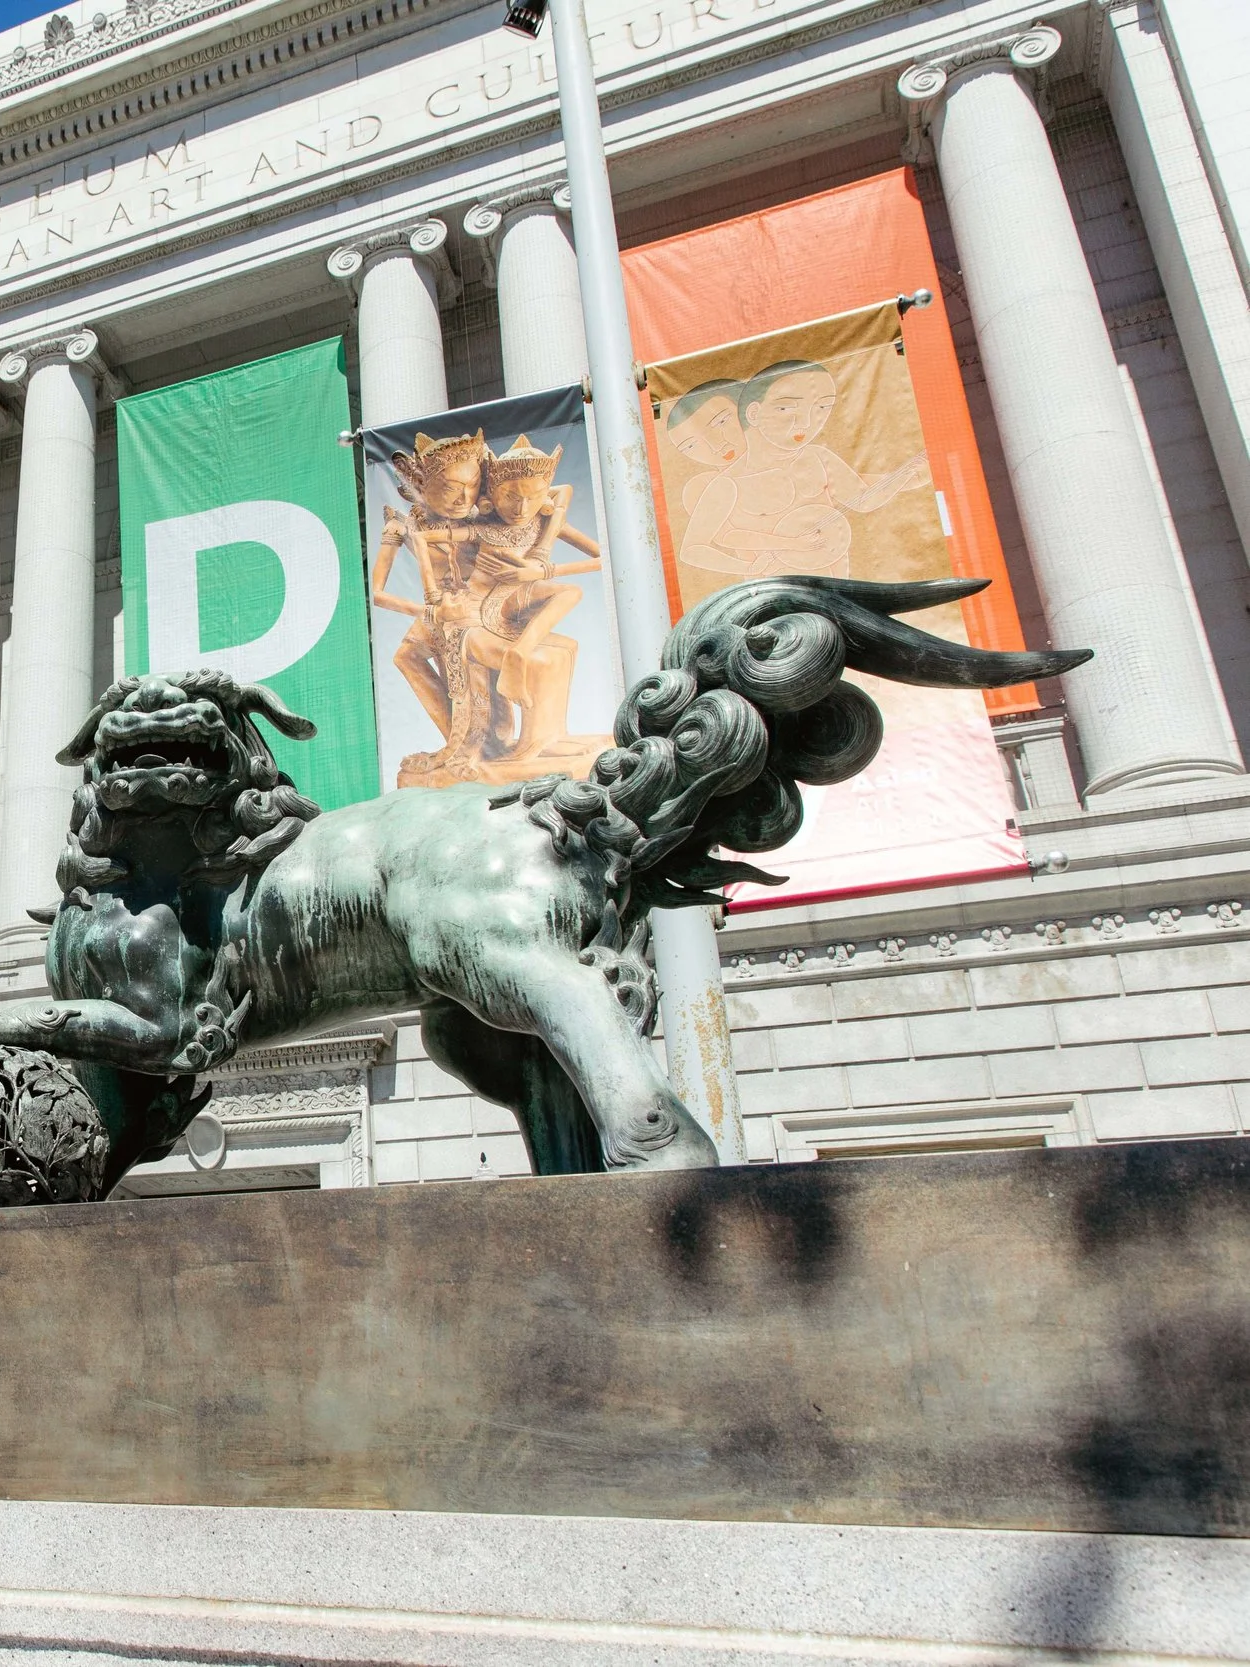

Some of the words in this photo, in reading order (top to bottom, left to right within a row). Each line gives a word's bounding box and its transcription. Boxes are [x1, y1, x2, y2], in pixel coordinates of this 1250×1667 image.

[106, 170, 213, 233] ART
[249, 115, 383, 185] AND
[145, 500, 341, 685] D
